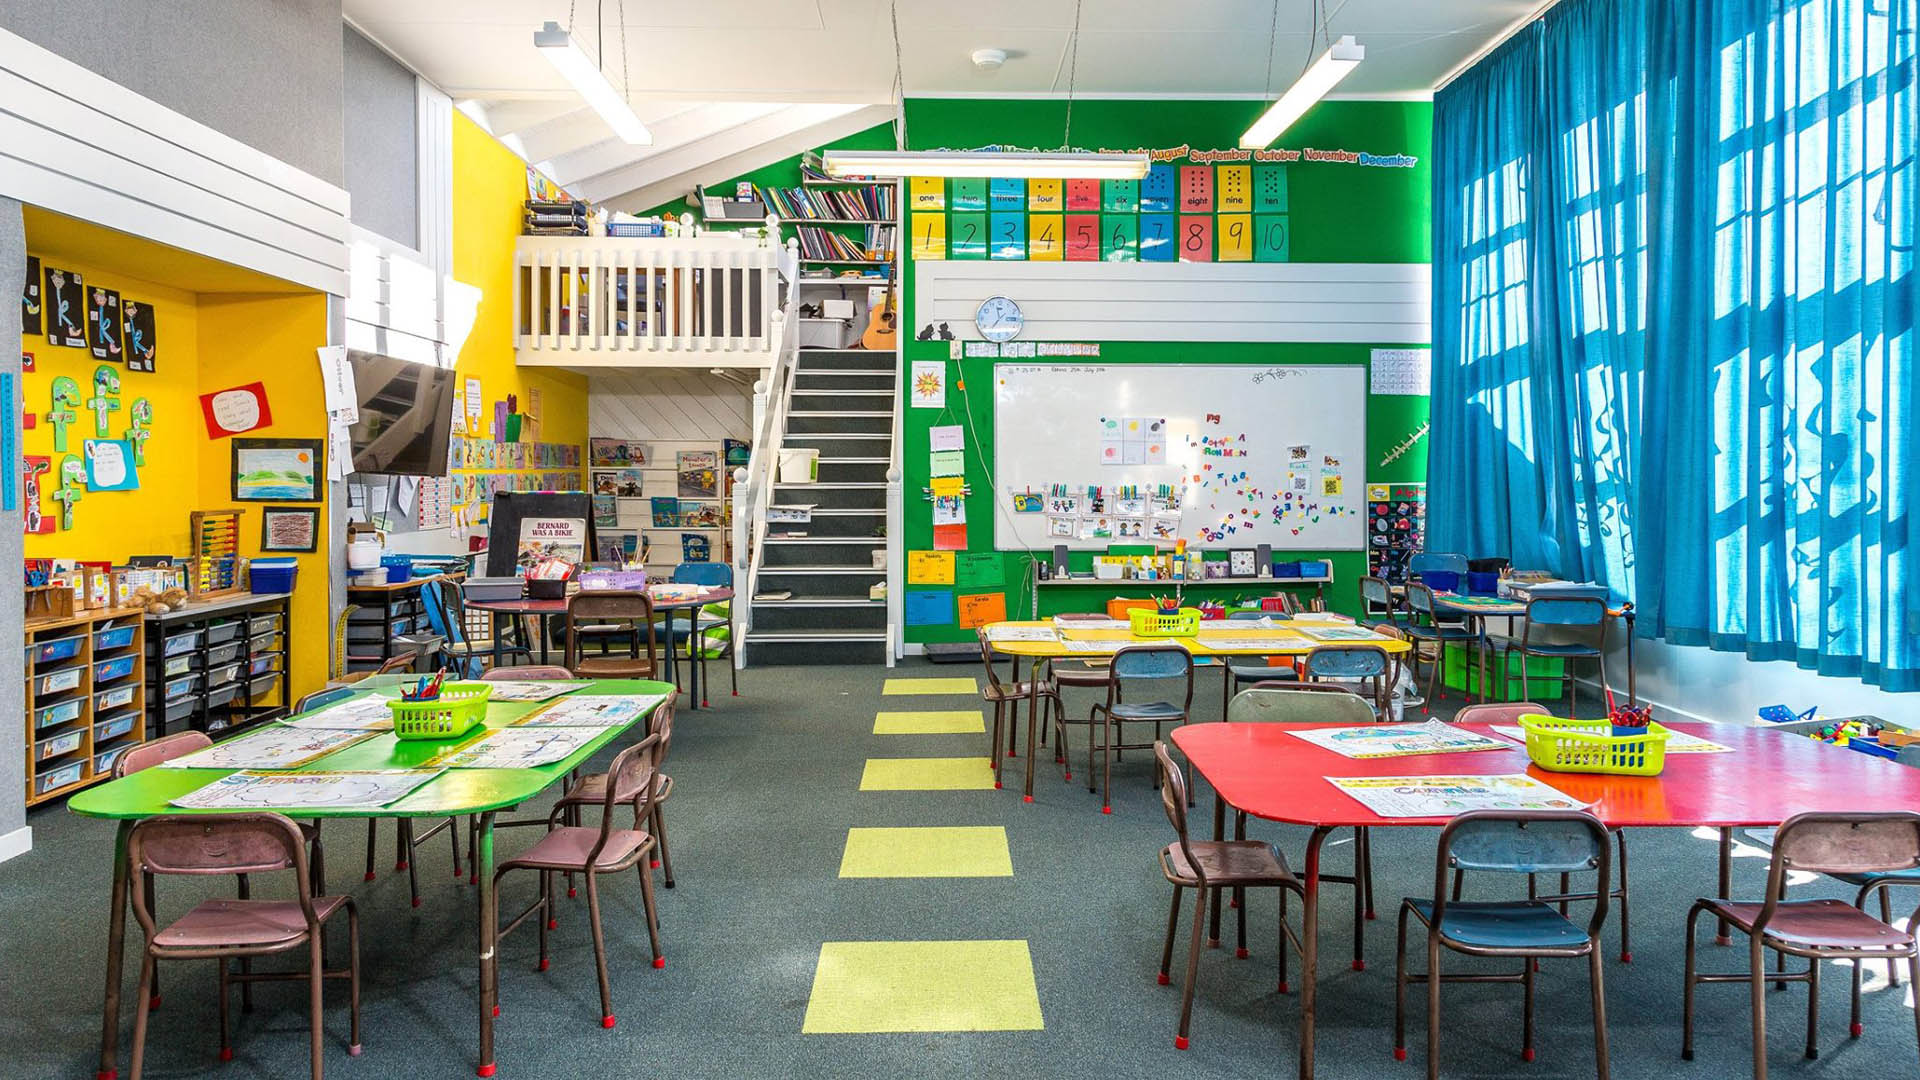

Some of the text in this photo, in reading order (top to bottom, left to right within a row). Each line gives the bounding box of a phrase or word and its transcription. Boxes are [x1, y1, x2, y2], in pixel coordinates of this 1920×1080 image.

[1151, 147, 1188, 162] August
[1191, 151, 1250, 164] September
[1256, 150, 1298, 161] October
[1305, 151, 1357, 162] November
[1361, 154, 1416, 166] December
[1037, 194, 1054, 203] four
[1116, 196, 1128, 204] six
[1187, 196, 1208, 206] eight
[1265, 197, 1278, 205] ten
[925, 223, 932, 249] 1
[962, 224, 976, 248] 2
[1004, 222, 1017, 248] 3
[1039, 223, 1054, 249] 4
[1077, 225, 1092, 249] 5
[1113, 224, 1126, 249] 6
[1152, 223, 1163, 249] 7
[1187, 223, 1204, 251] 8
[1229, 222, 1244, 249] 9
[1264, 223, 1284, 251] 10
